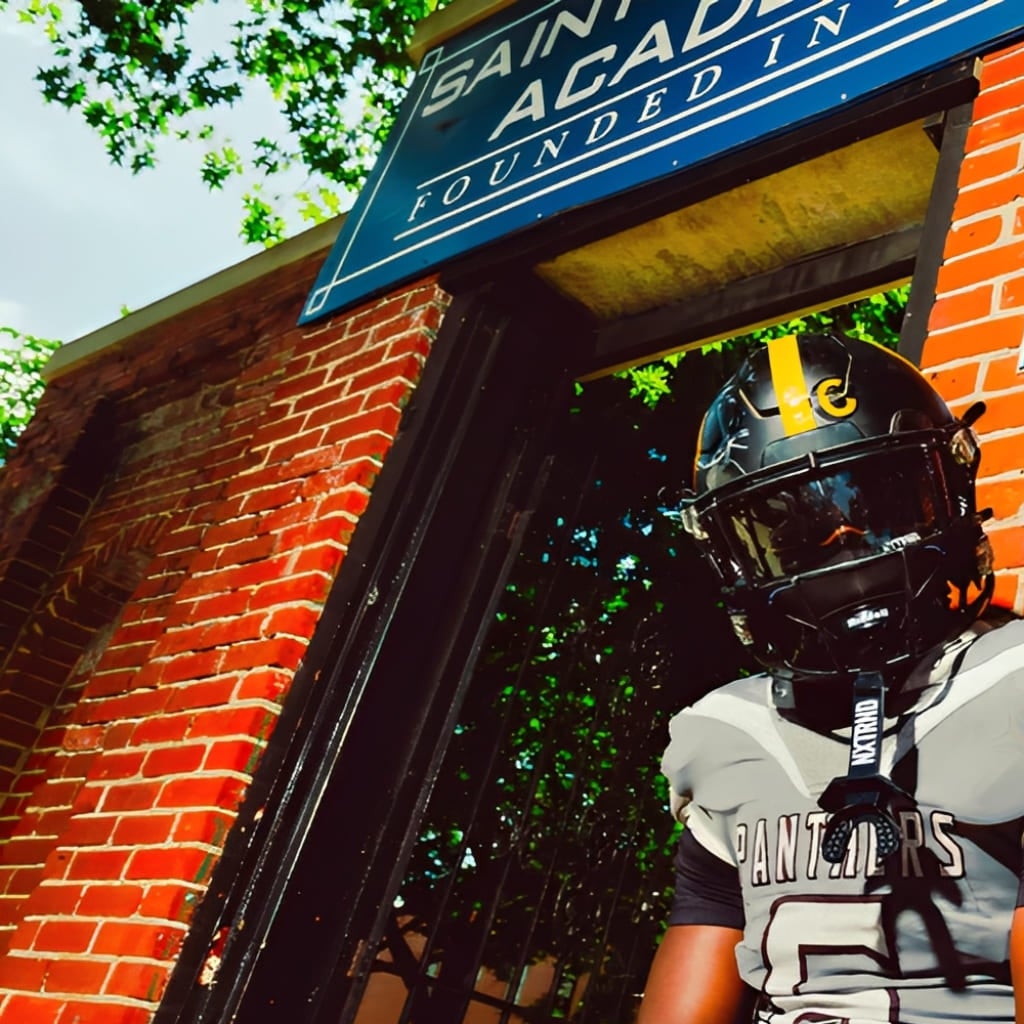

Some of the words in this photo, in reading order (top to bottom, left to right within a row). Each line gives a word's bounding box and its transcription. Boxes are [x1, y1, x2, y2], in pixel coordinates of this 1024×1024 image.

[407, 64, 723, 223] FOUNDED
[763, 3, 851, 69] IN
[421, 0, 633, 117] SAIN
[487, 0, 796, 142] ACAD
[850, 698, 880, 767] NXTRND
